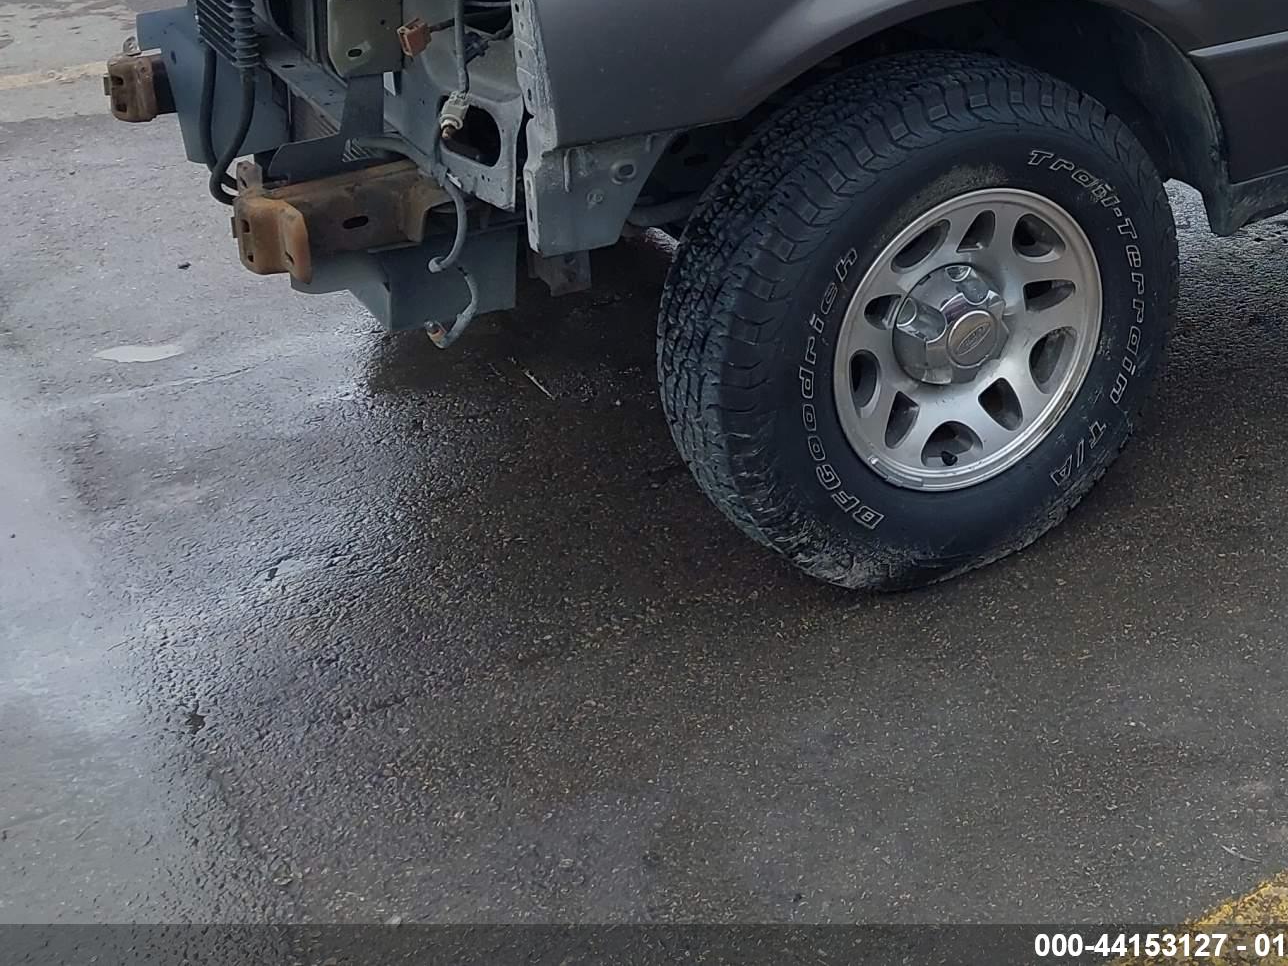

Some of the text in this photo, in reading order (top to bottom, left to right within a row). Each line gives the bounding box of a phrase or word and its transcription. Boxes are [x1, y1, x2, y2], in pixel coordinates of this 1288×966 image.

[798, 247, 885, 530] BFGoodrich
[1028, 149, 1145, 487] Trail-Terrain T/A
